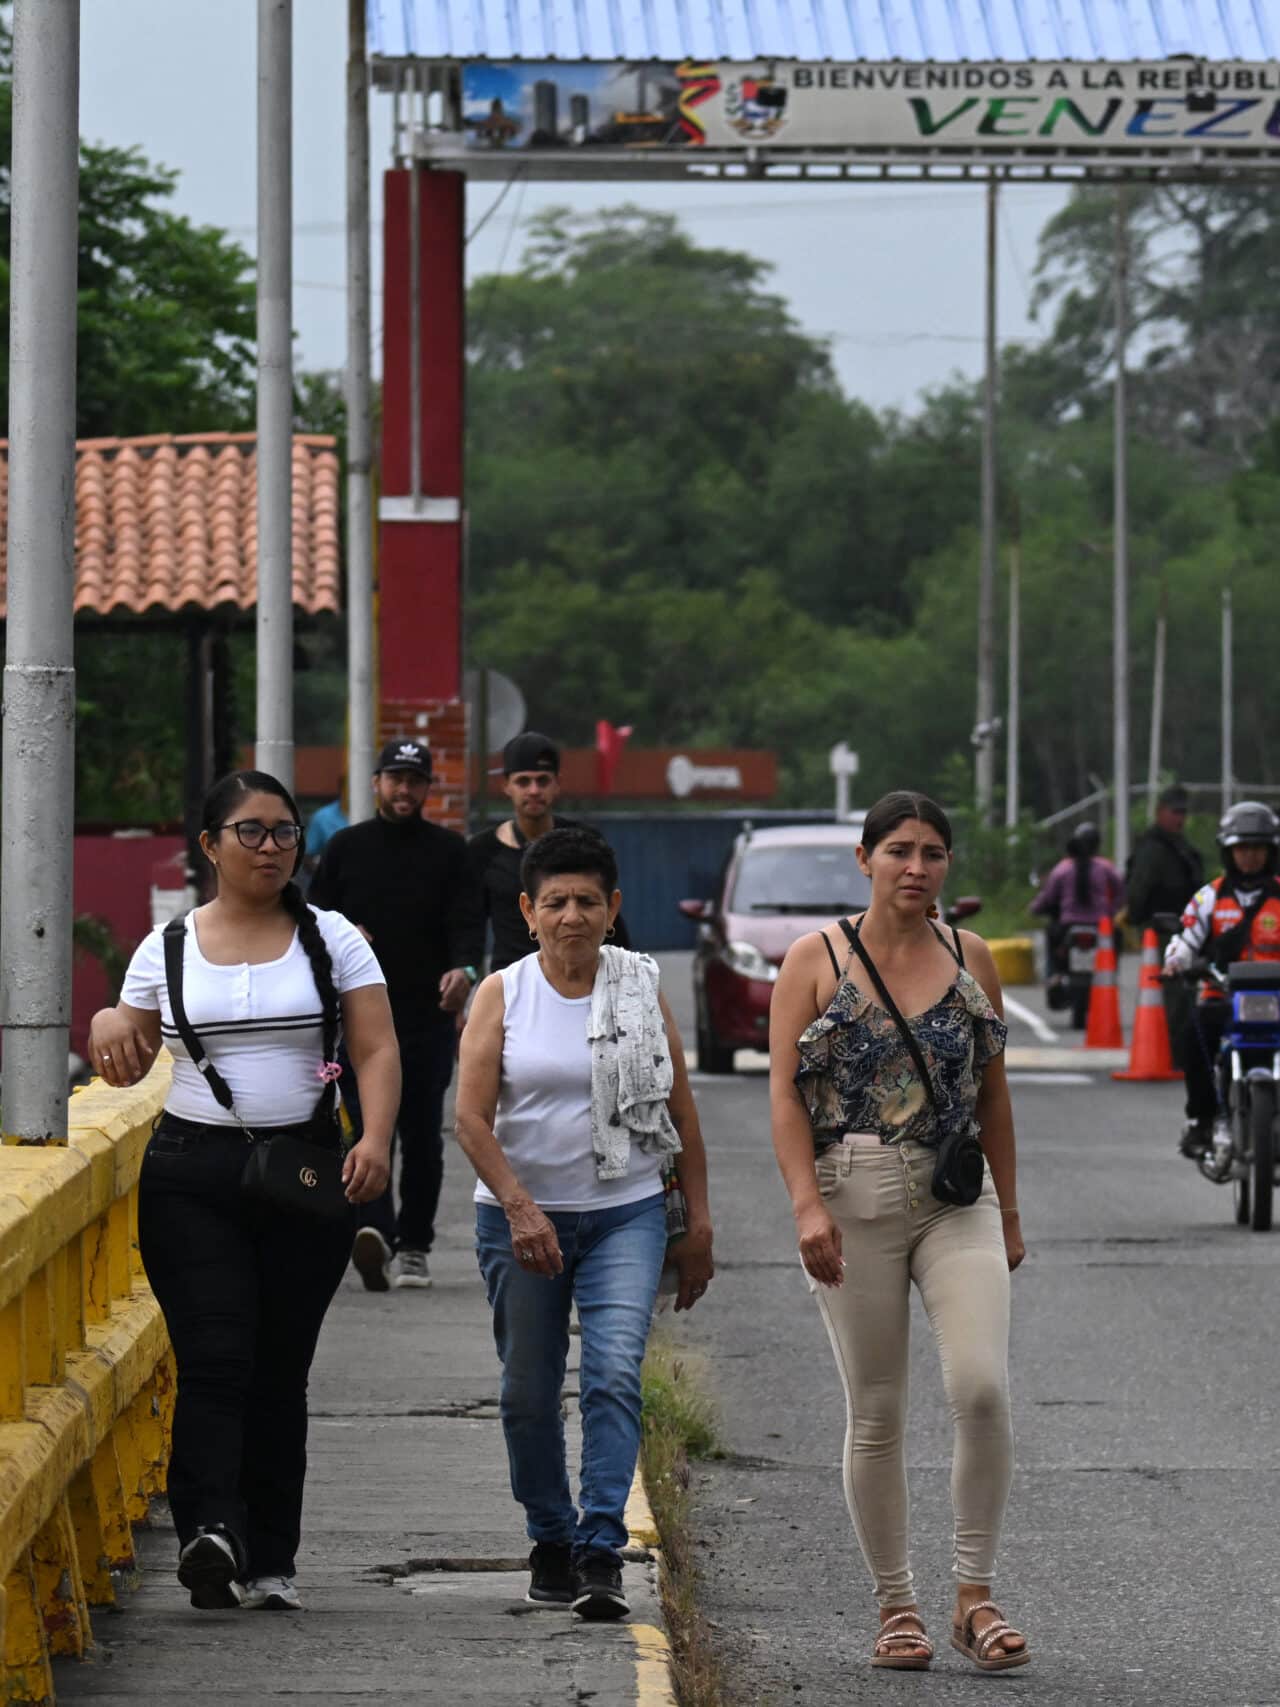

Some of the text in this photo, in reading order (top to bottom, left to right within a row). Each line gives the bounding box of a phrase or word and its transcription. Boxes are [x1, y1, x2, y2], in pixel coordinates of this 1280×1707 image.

[793, 67, 1034, 89] BIENVENIDOS
[1046, 69, 1070, 89] A
[1082, 69, 1124, 90] LA
